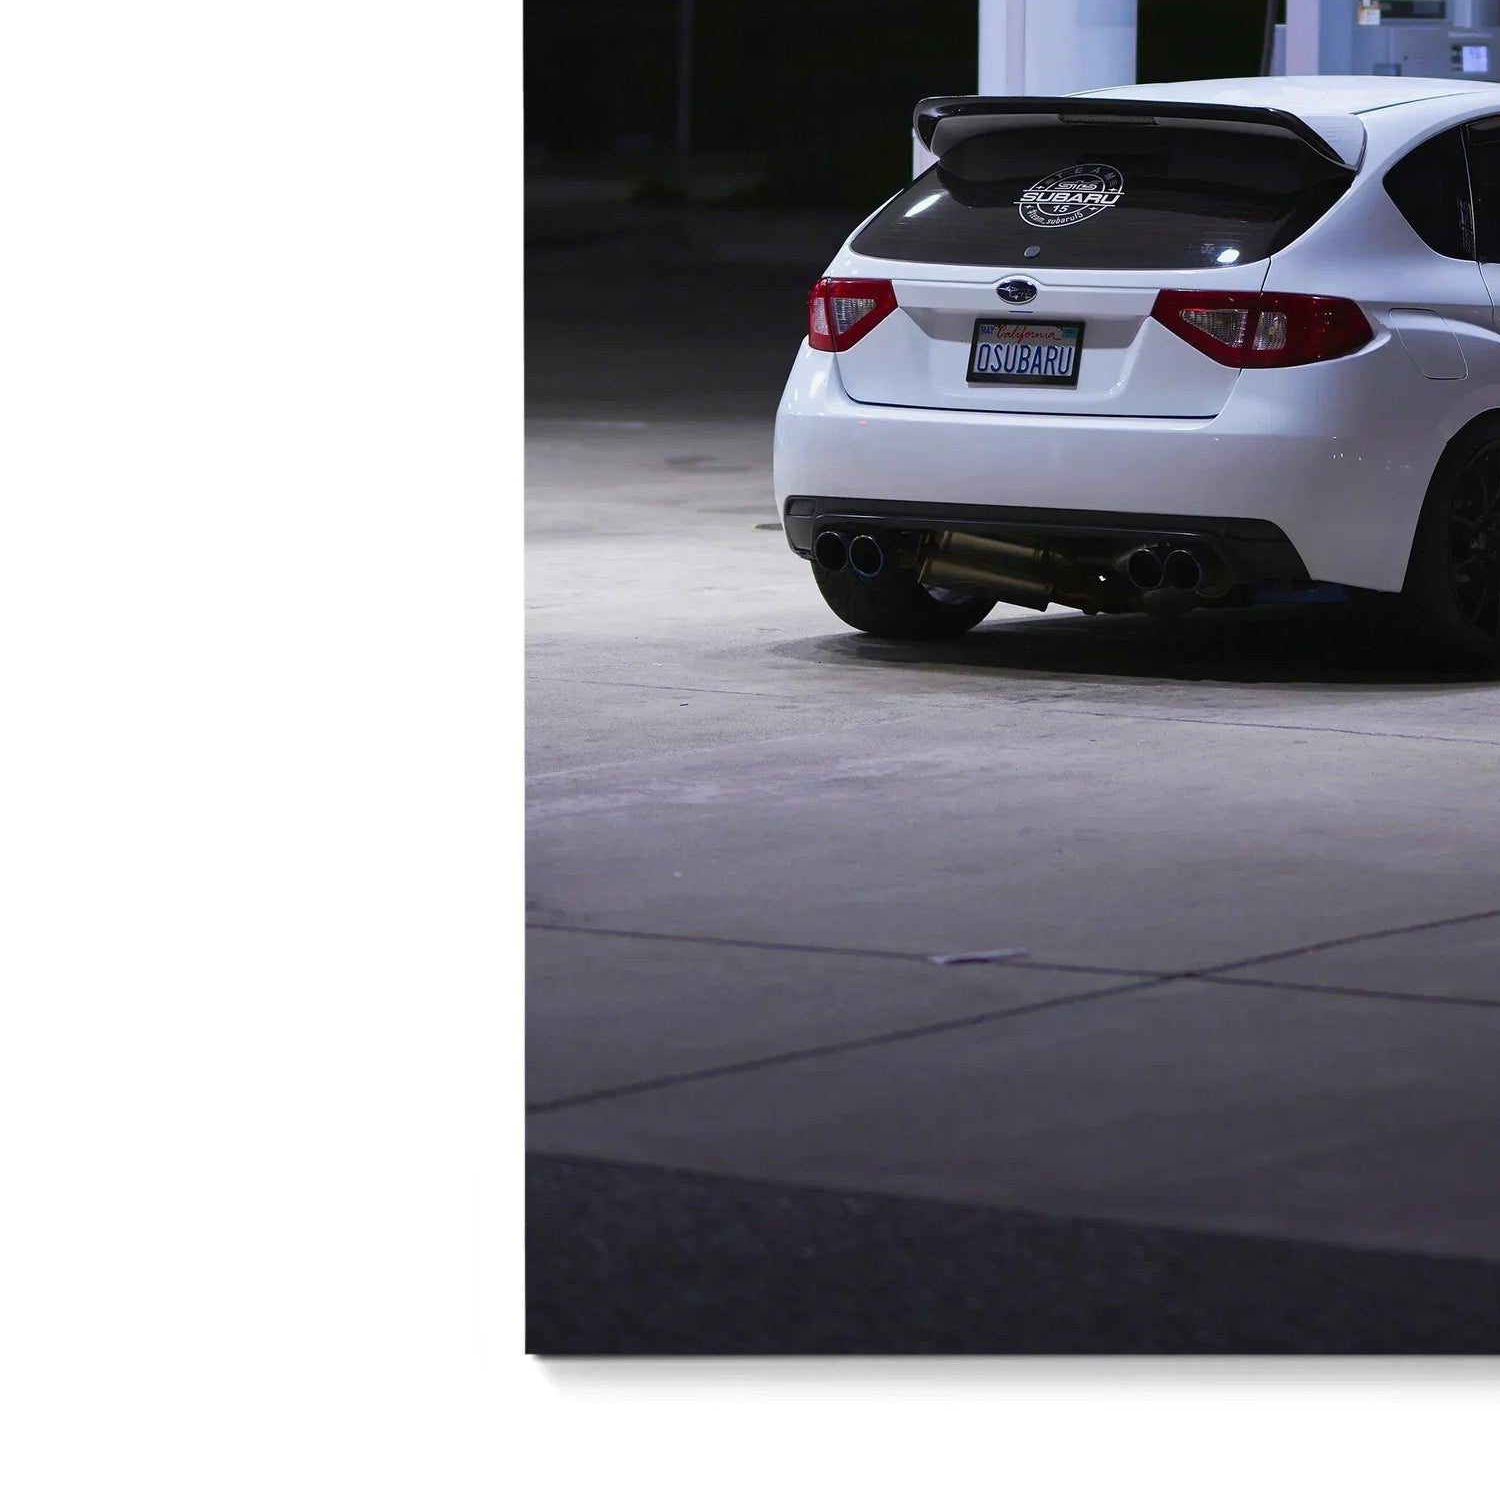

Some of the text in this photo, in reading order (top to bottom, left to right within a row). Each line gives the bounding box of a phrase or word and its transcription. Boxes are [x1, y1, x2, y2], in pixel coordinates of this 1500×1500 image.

[1020, 192, 1120, 204] SUBARU
[1053, 205, 1070, 213] 15
[980, 326, 995, 335] MAY
[996, 324, 1061, 343] California
